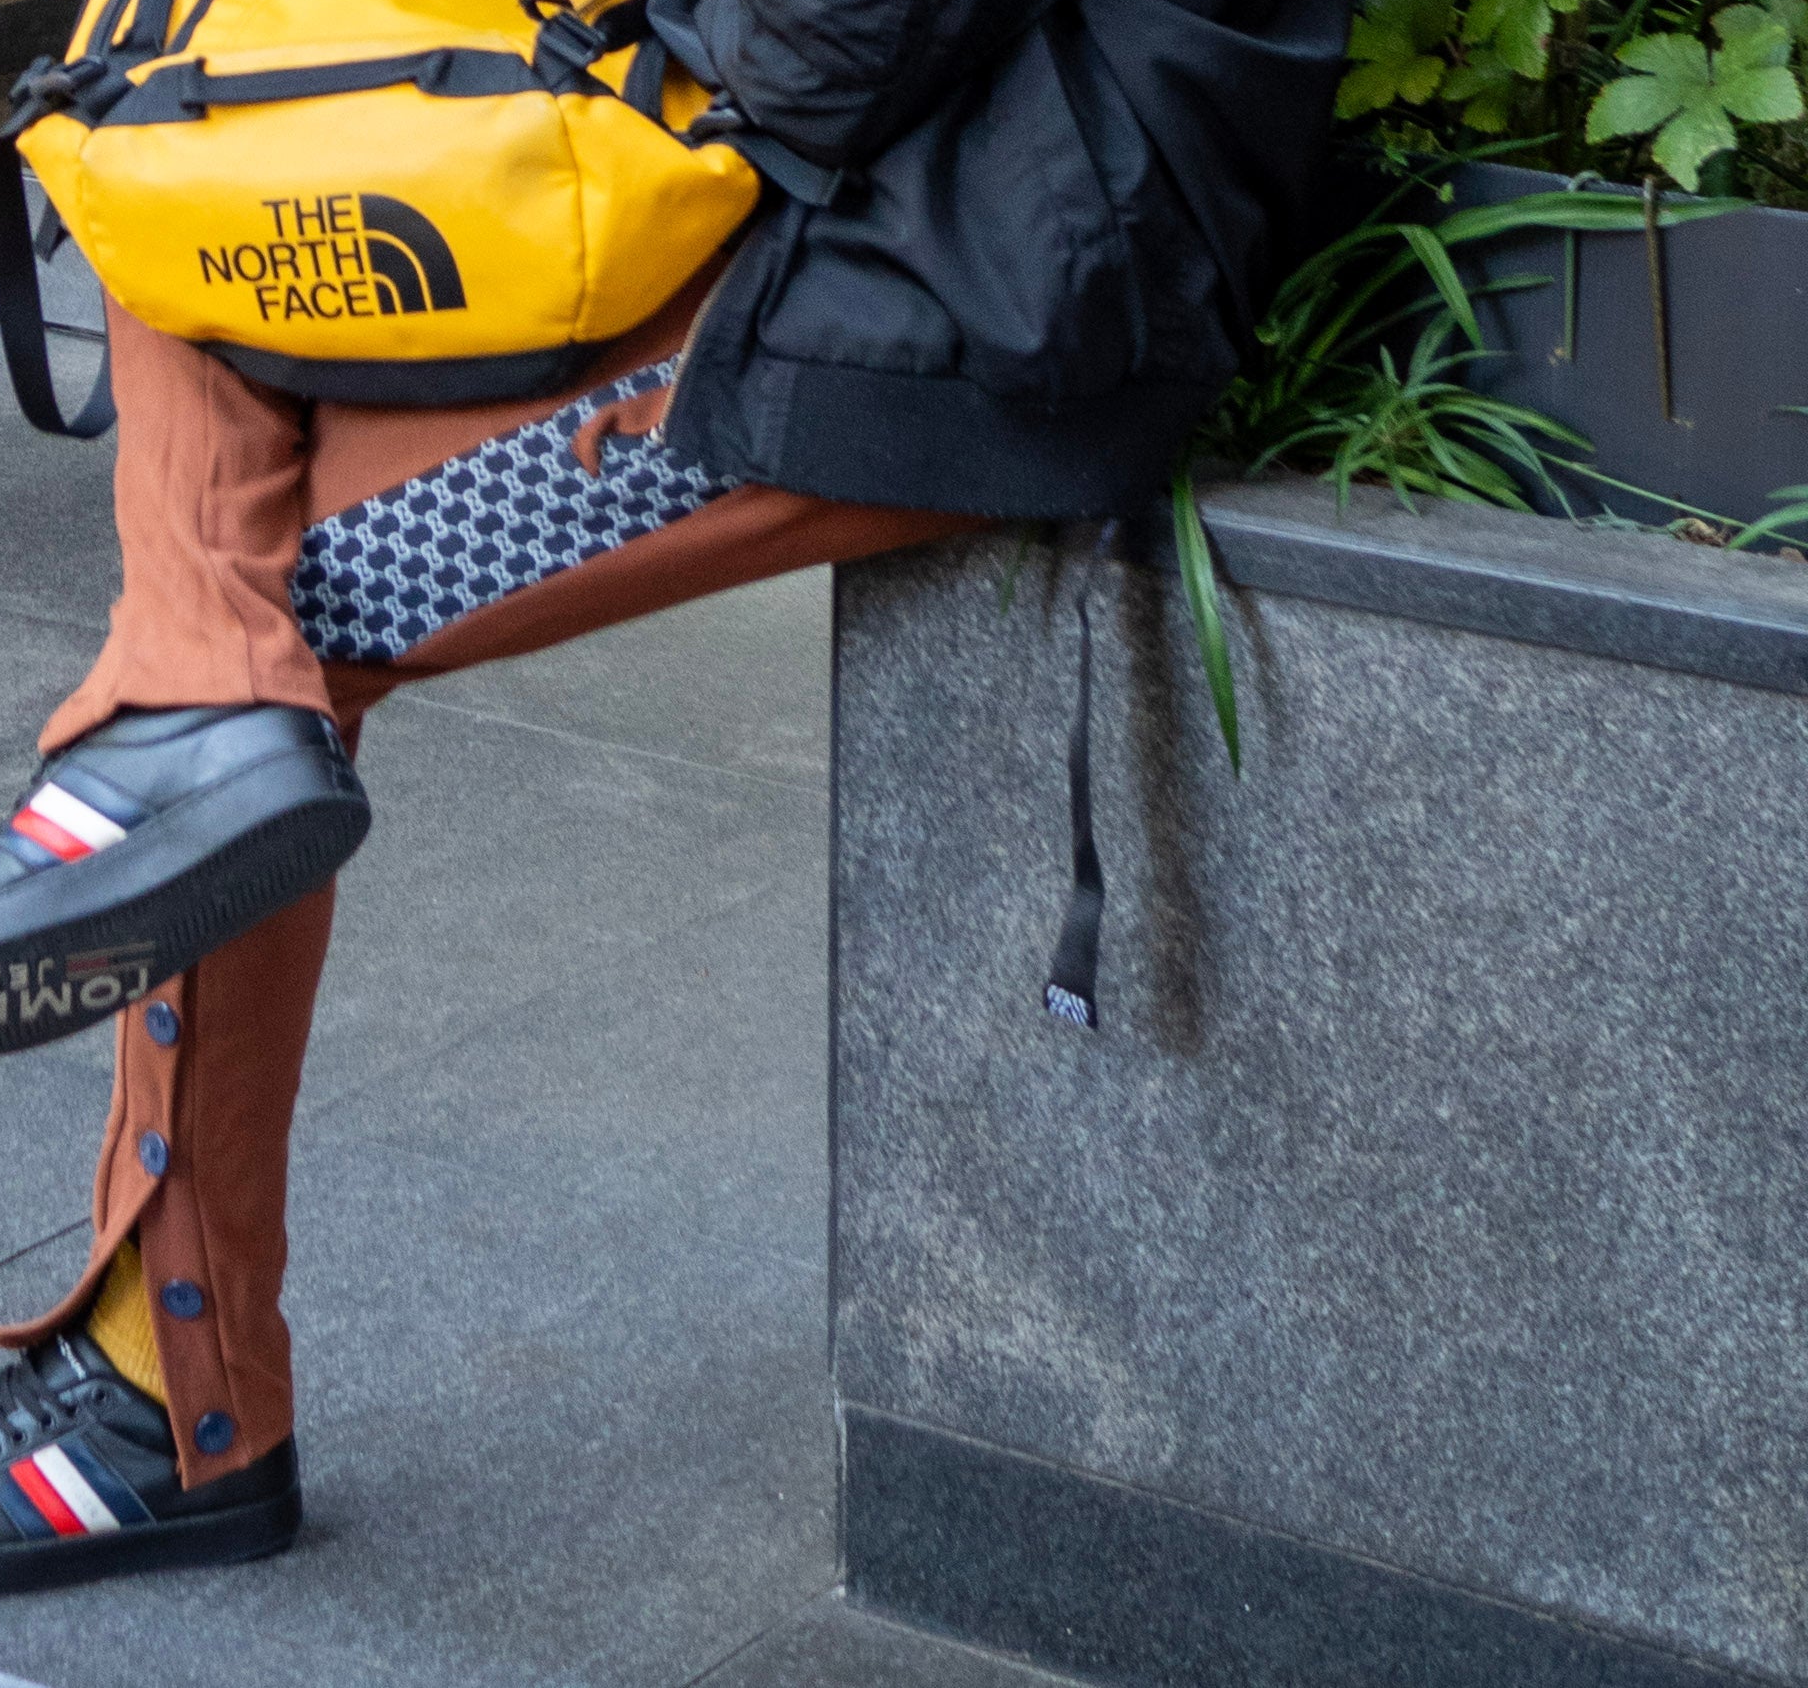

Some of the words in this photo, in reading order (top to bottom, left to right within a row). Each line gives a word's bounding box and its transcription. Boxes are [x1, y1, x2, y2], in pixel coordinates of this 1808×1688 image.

[261, 193, 354, 239] THE
[197, 235, 366, 285] NORTH
[255, 279, 376, 323] FACE
